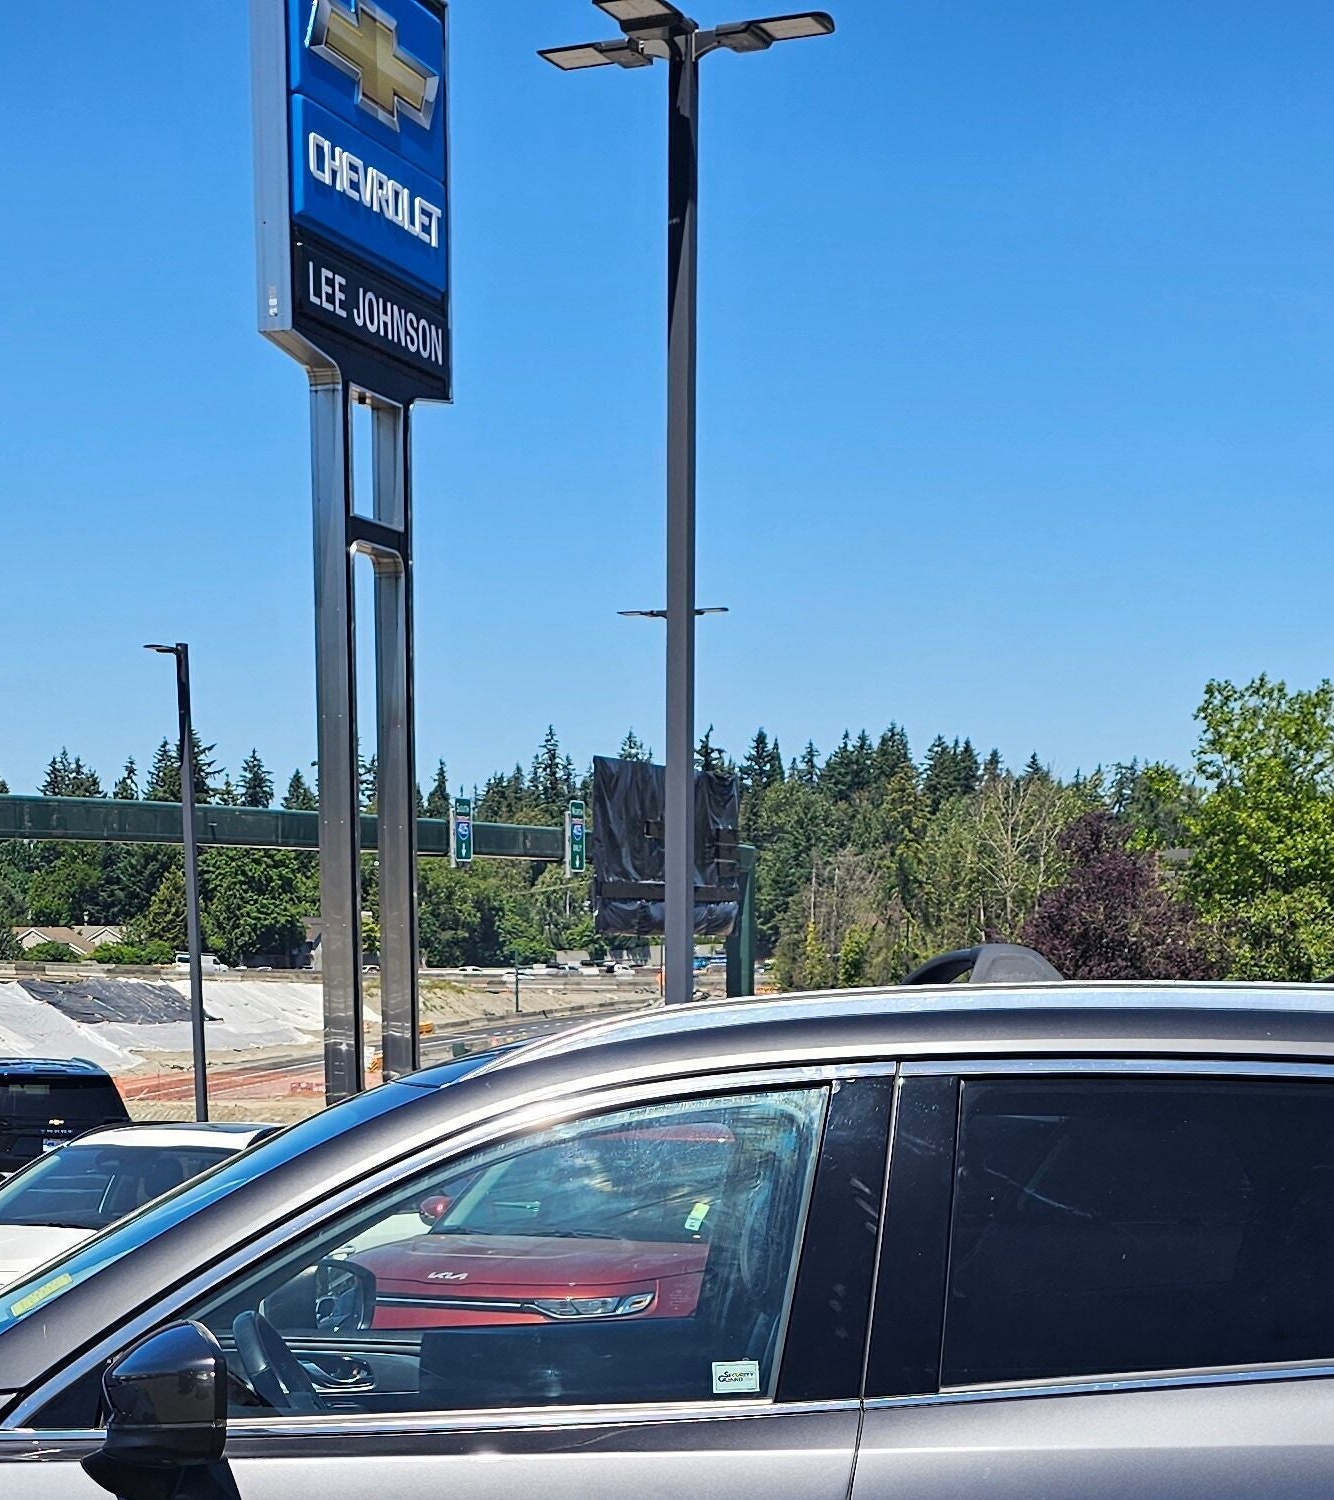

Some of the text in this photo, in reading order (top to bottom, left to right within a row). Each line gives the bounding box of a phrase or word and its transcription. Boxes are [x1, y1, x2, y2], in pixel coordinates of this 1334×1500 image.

[308, 132, 442, 248] CHEVROLET
[308, 261, 443, 366] LEE JOHNSON
